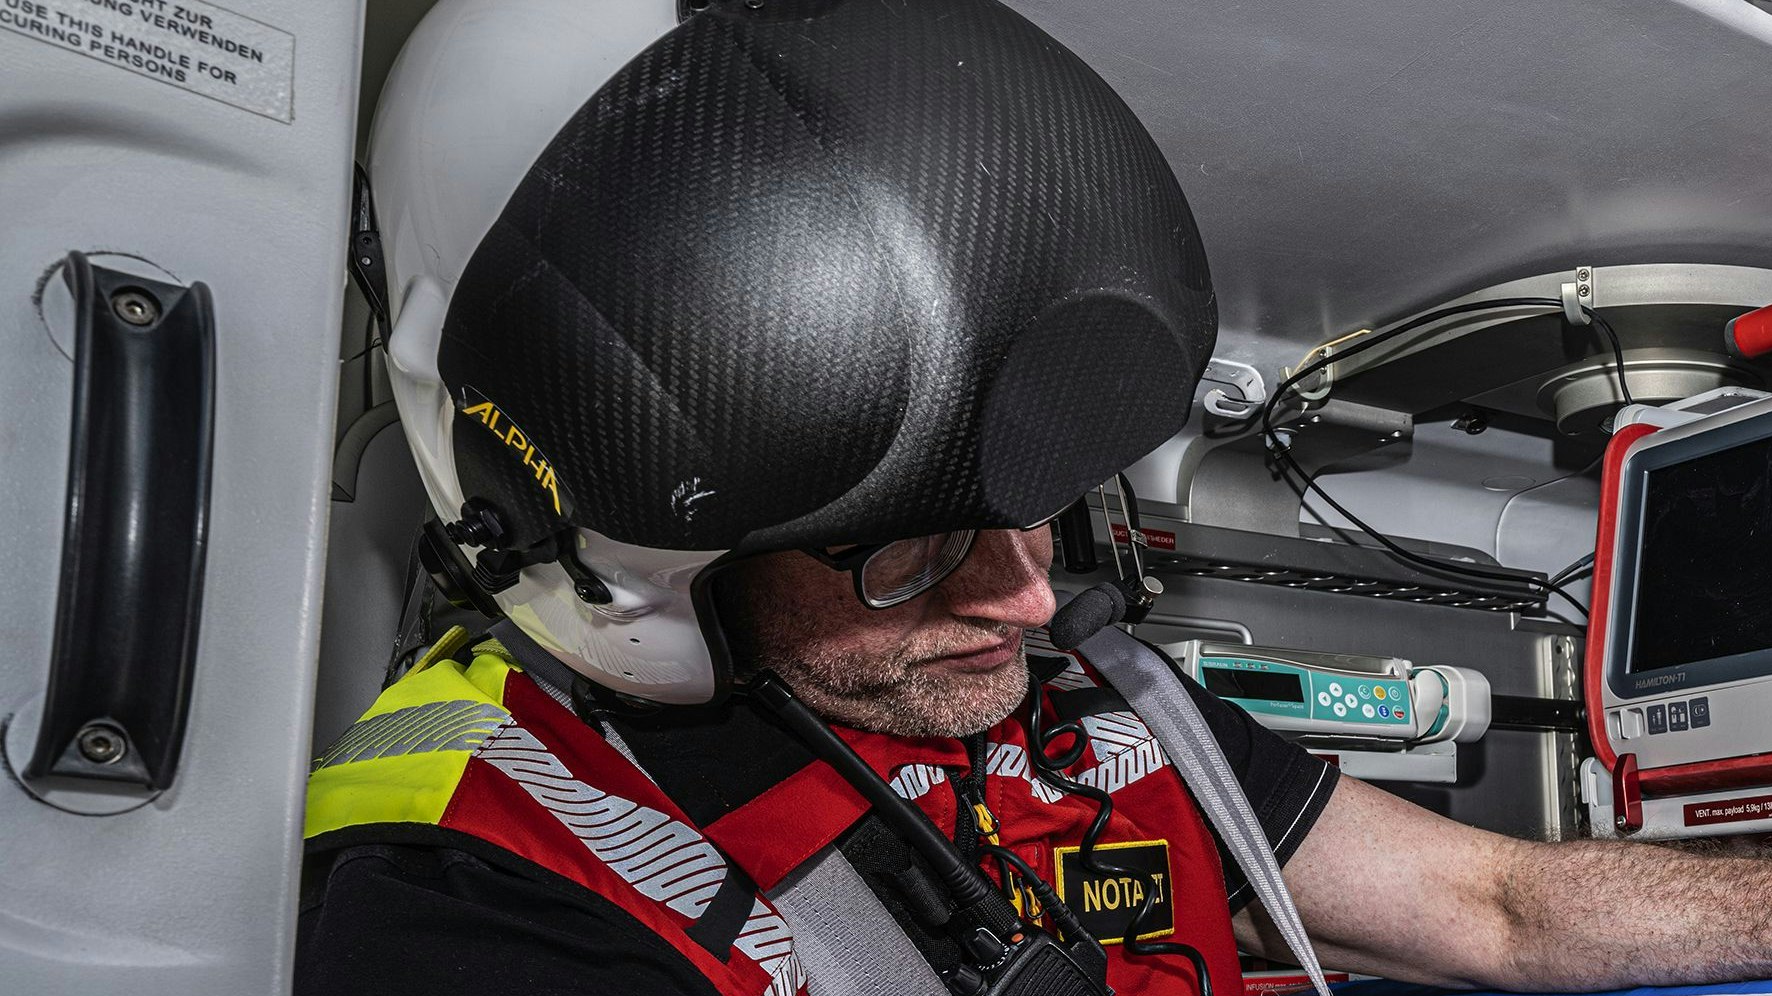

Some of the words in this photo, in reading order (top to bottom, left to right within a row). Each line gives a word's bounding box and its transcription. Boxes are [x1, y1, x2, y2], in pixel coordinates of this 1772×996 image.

[140, 12, 263, 63] VERWENDEN
[174, 6, 213, 29] ZUR
[8, 0, 48, 20] USE
[57, 12, 103, 38] THIS
[111, 32, 190, 69] HANDLE
[198, 61, 237, 85] FOR
[90, 40, 187, 83] PERSONS
[463, 402, 561, 516] ALPHA
[1695, 809, 1711, 818] VENT.
[1725, 805, 1744, 816] payload
[1083, 873, 1164, 912] NOTAT
